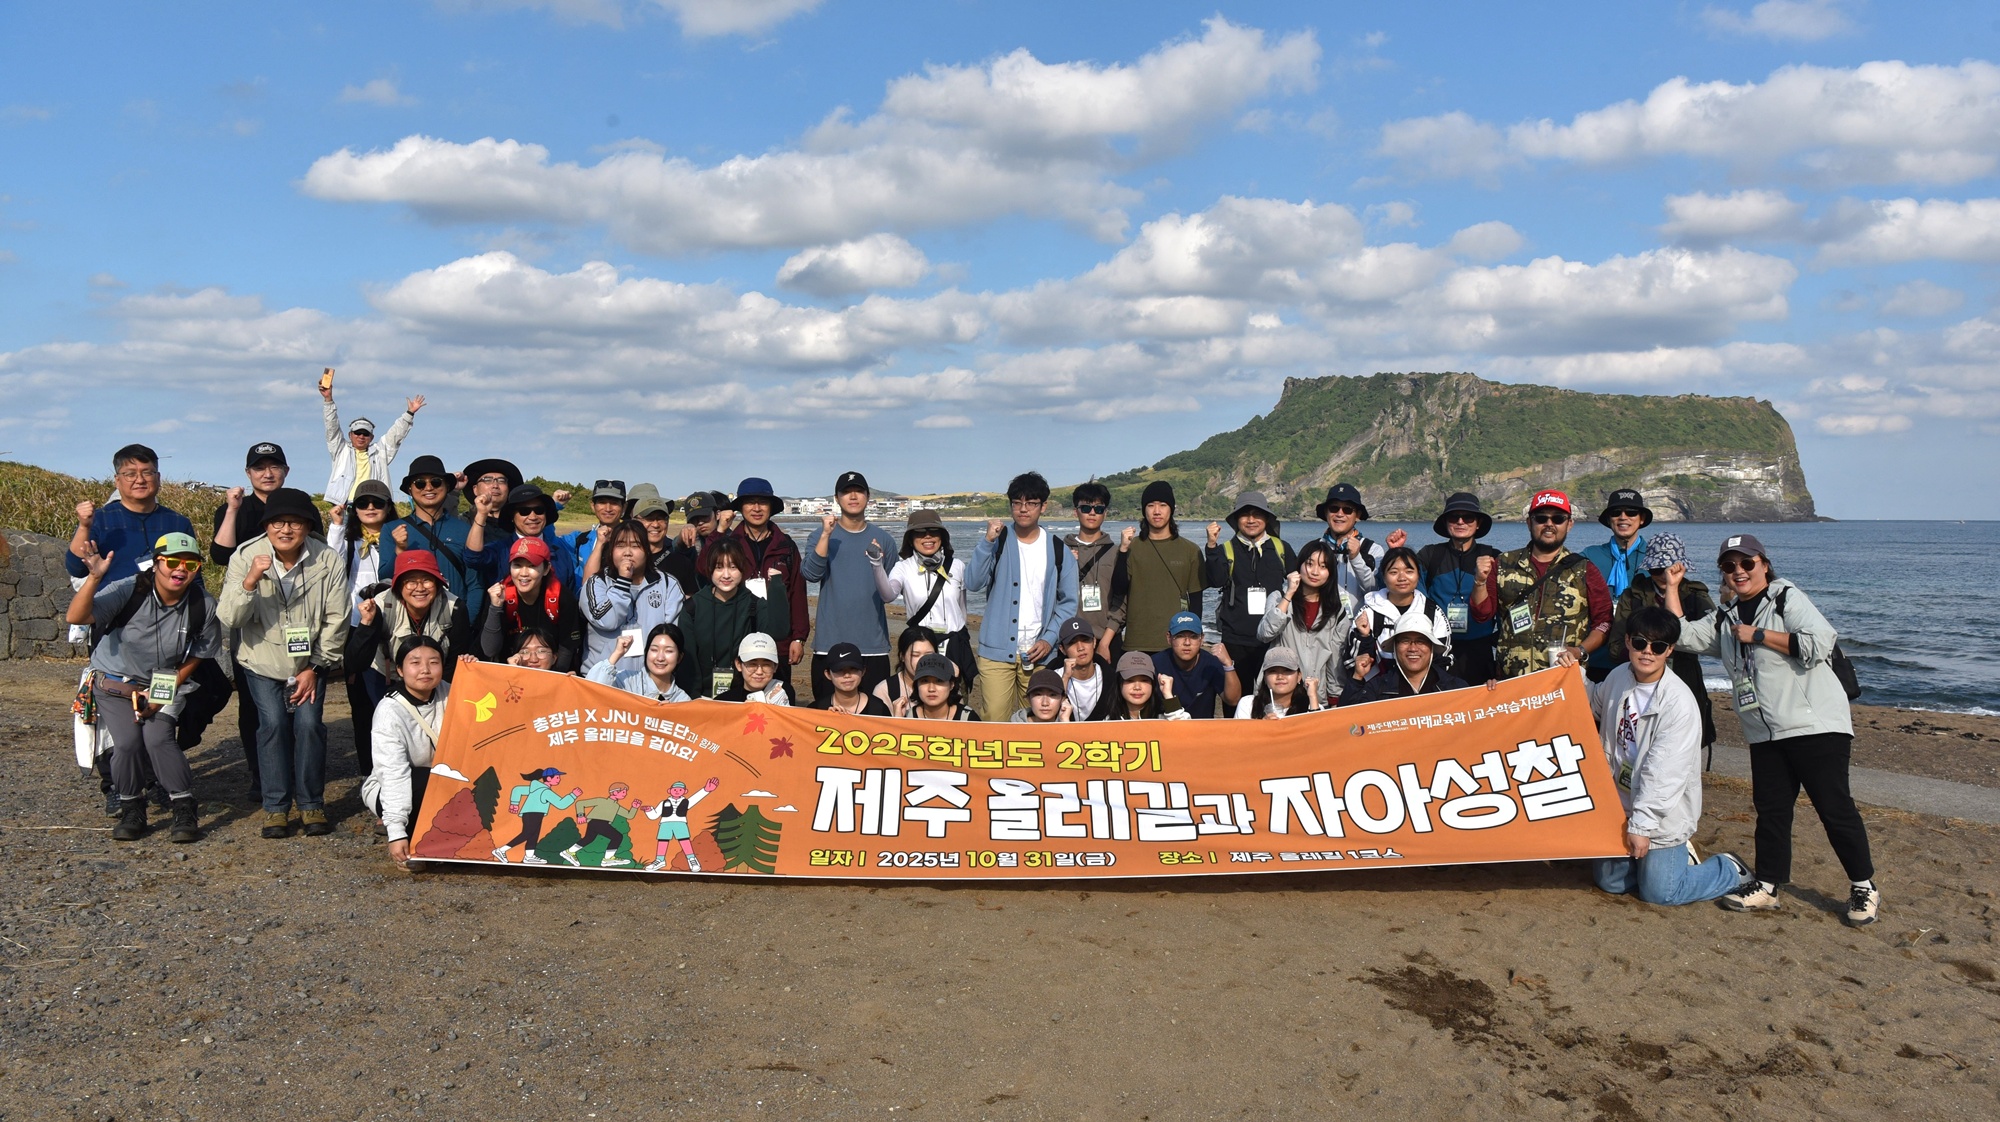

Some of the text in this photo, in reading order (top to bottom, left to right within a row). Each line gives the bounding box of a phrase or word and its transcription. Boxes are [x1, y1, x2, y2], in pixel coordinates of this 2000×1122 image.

[1072, 622, 1080, 630] C
[1366, 718, 1409, 731] 제주대학교
[1409, 712, 1466, 729] 미래교육과
[1473, 688, 1566, 721] 교수학습지원센터
[532, 708, 720, 754] 총장님 X JNU 멘토단과 함께
[547, 727, 698, 762] 제주 올레길을 걸어요!
[815, 725, 1163, 773] 2025학년도 2학기
[811, 734, 1595, 842] 제주 올레길과 자아성찰
[809, 849, 853, 867] 일자
[877, 850, 960, 868] 2025년
[965, 849, 1019, 868] 10월
[1023, 850, 1117, 868] 31일(금)
[1158, 850, 1203, 865] 장소
[1228, 851, 1274, 863] 제주
[1346, 847, 1405, 860] 1코스
